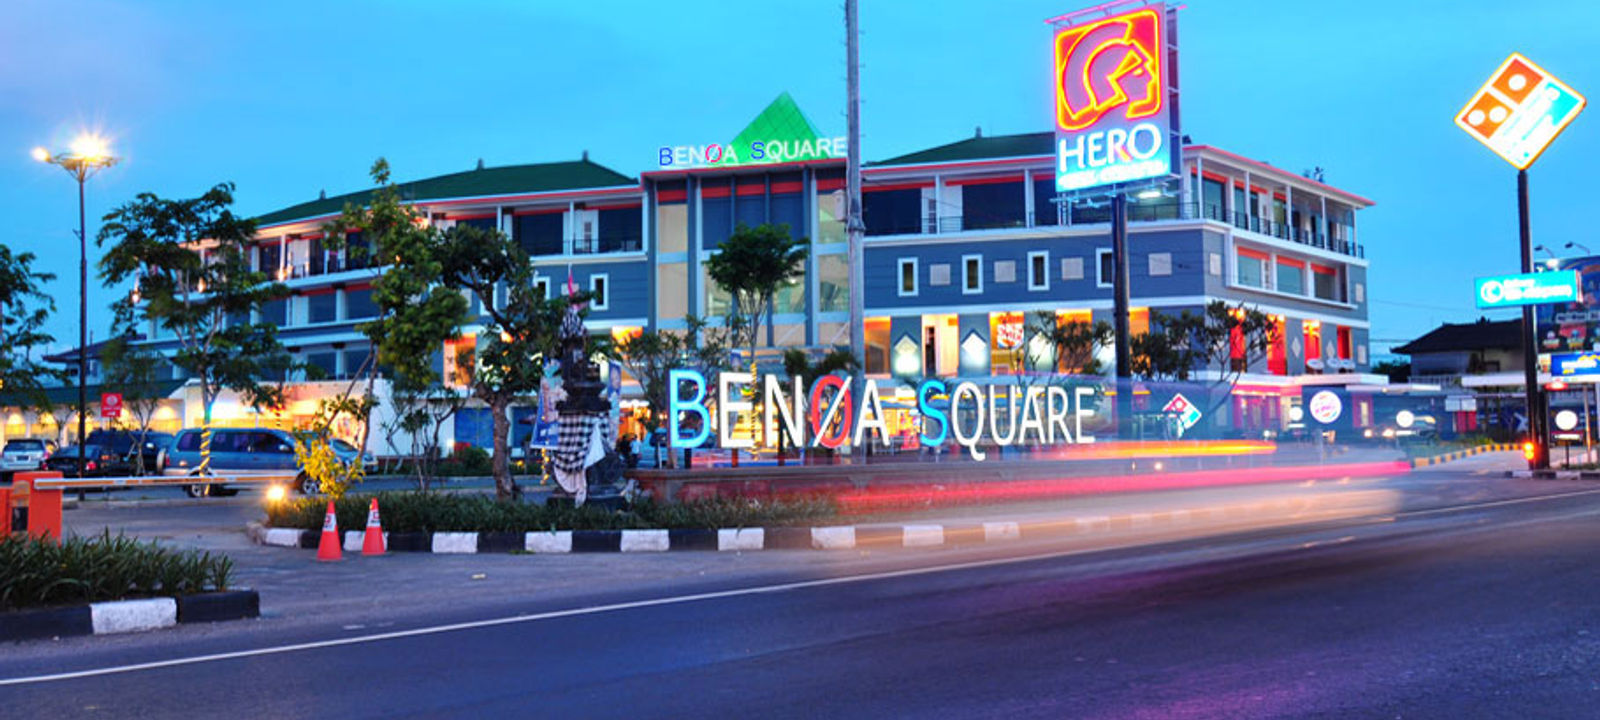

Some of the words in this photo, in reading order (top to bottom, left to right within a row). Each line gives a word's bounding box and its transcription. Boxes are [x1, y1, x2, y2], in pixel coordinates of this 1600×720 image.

[750, 137, 848, 163] SQUARE
[1058, 123, 1162, 173] HERO
[917, 379, 1096, 461] SQUARE
